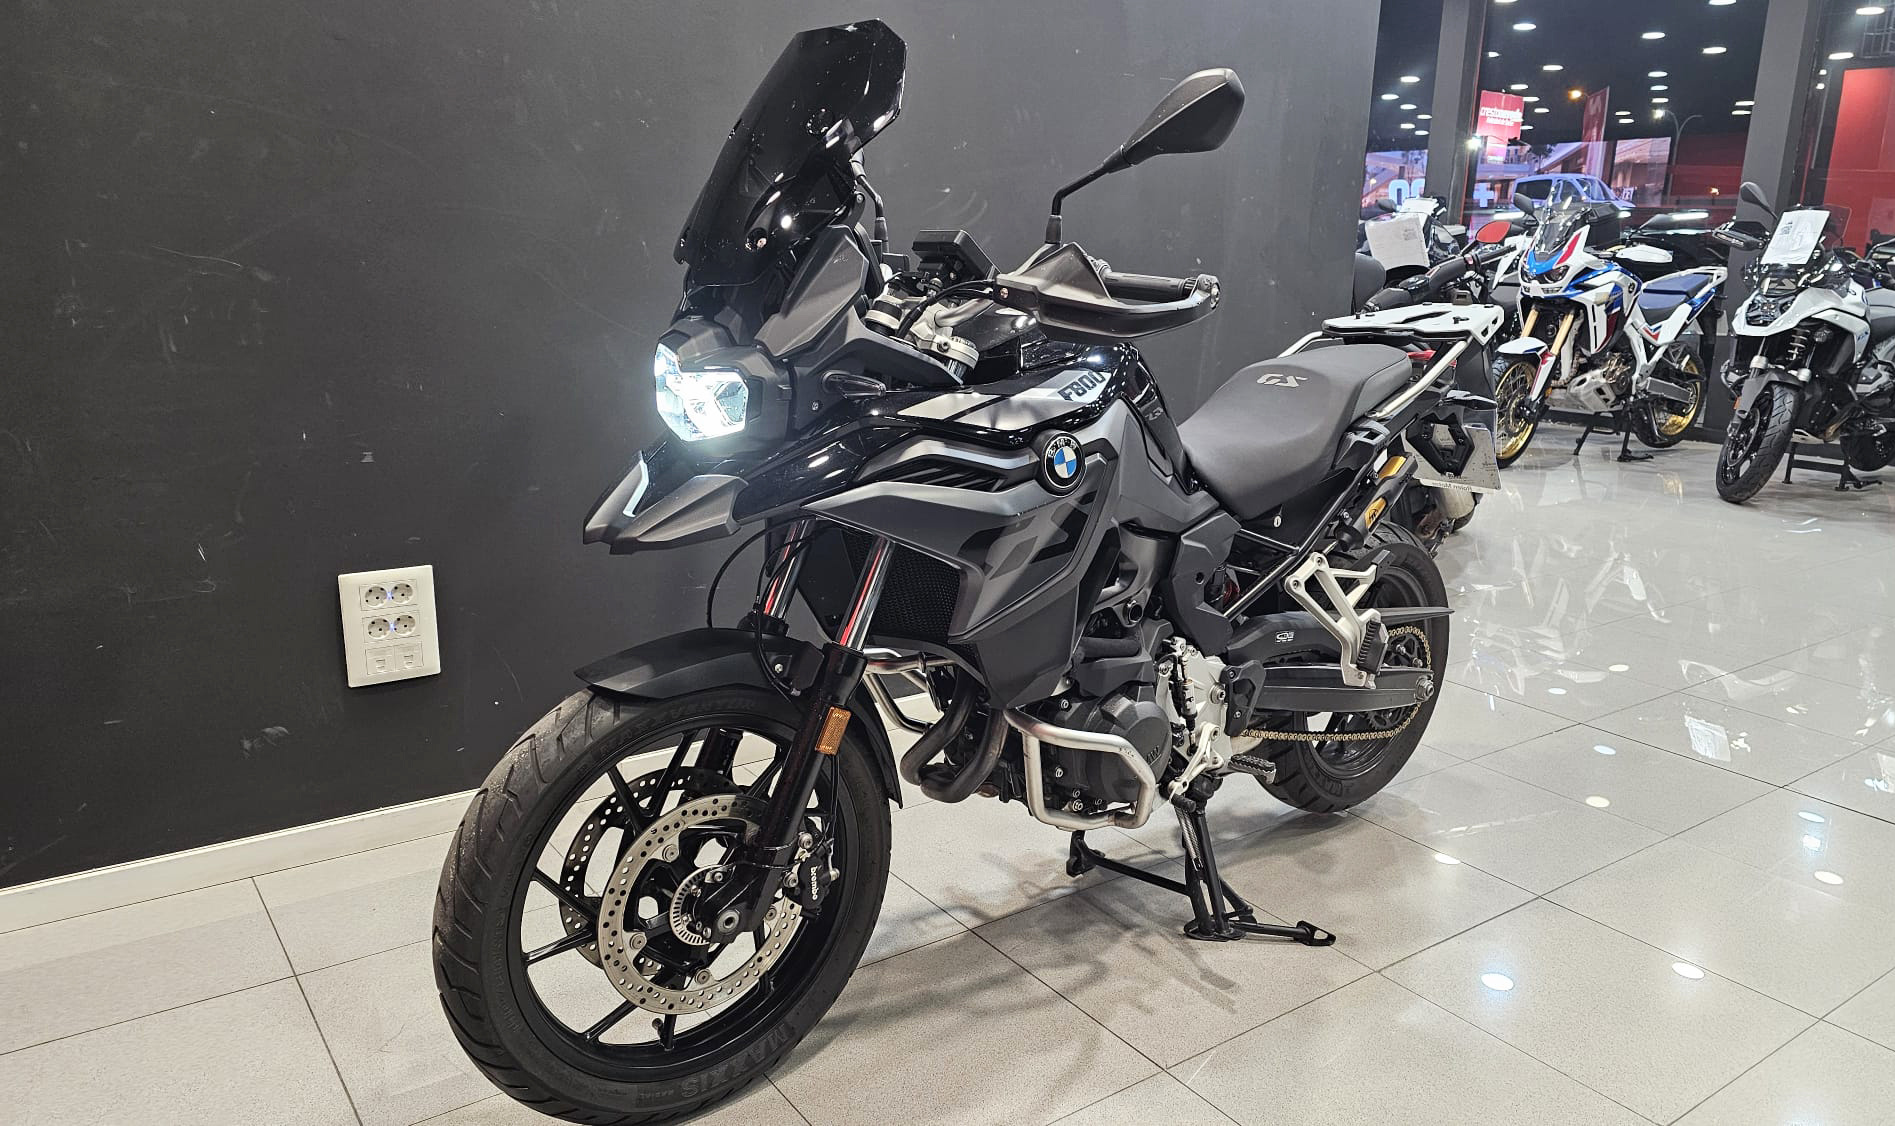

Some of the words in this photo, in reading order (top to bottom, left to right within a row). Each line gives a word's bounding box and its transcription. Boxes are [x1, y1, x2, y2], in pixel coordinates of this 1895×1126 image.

[1057, 370, 1107, 402] F800
[1256, 373, 1308, 388] GS
[1047, 438, 1078, 458] BMW
[810, 865, 819, 901] brembo
